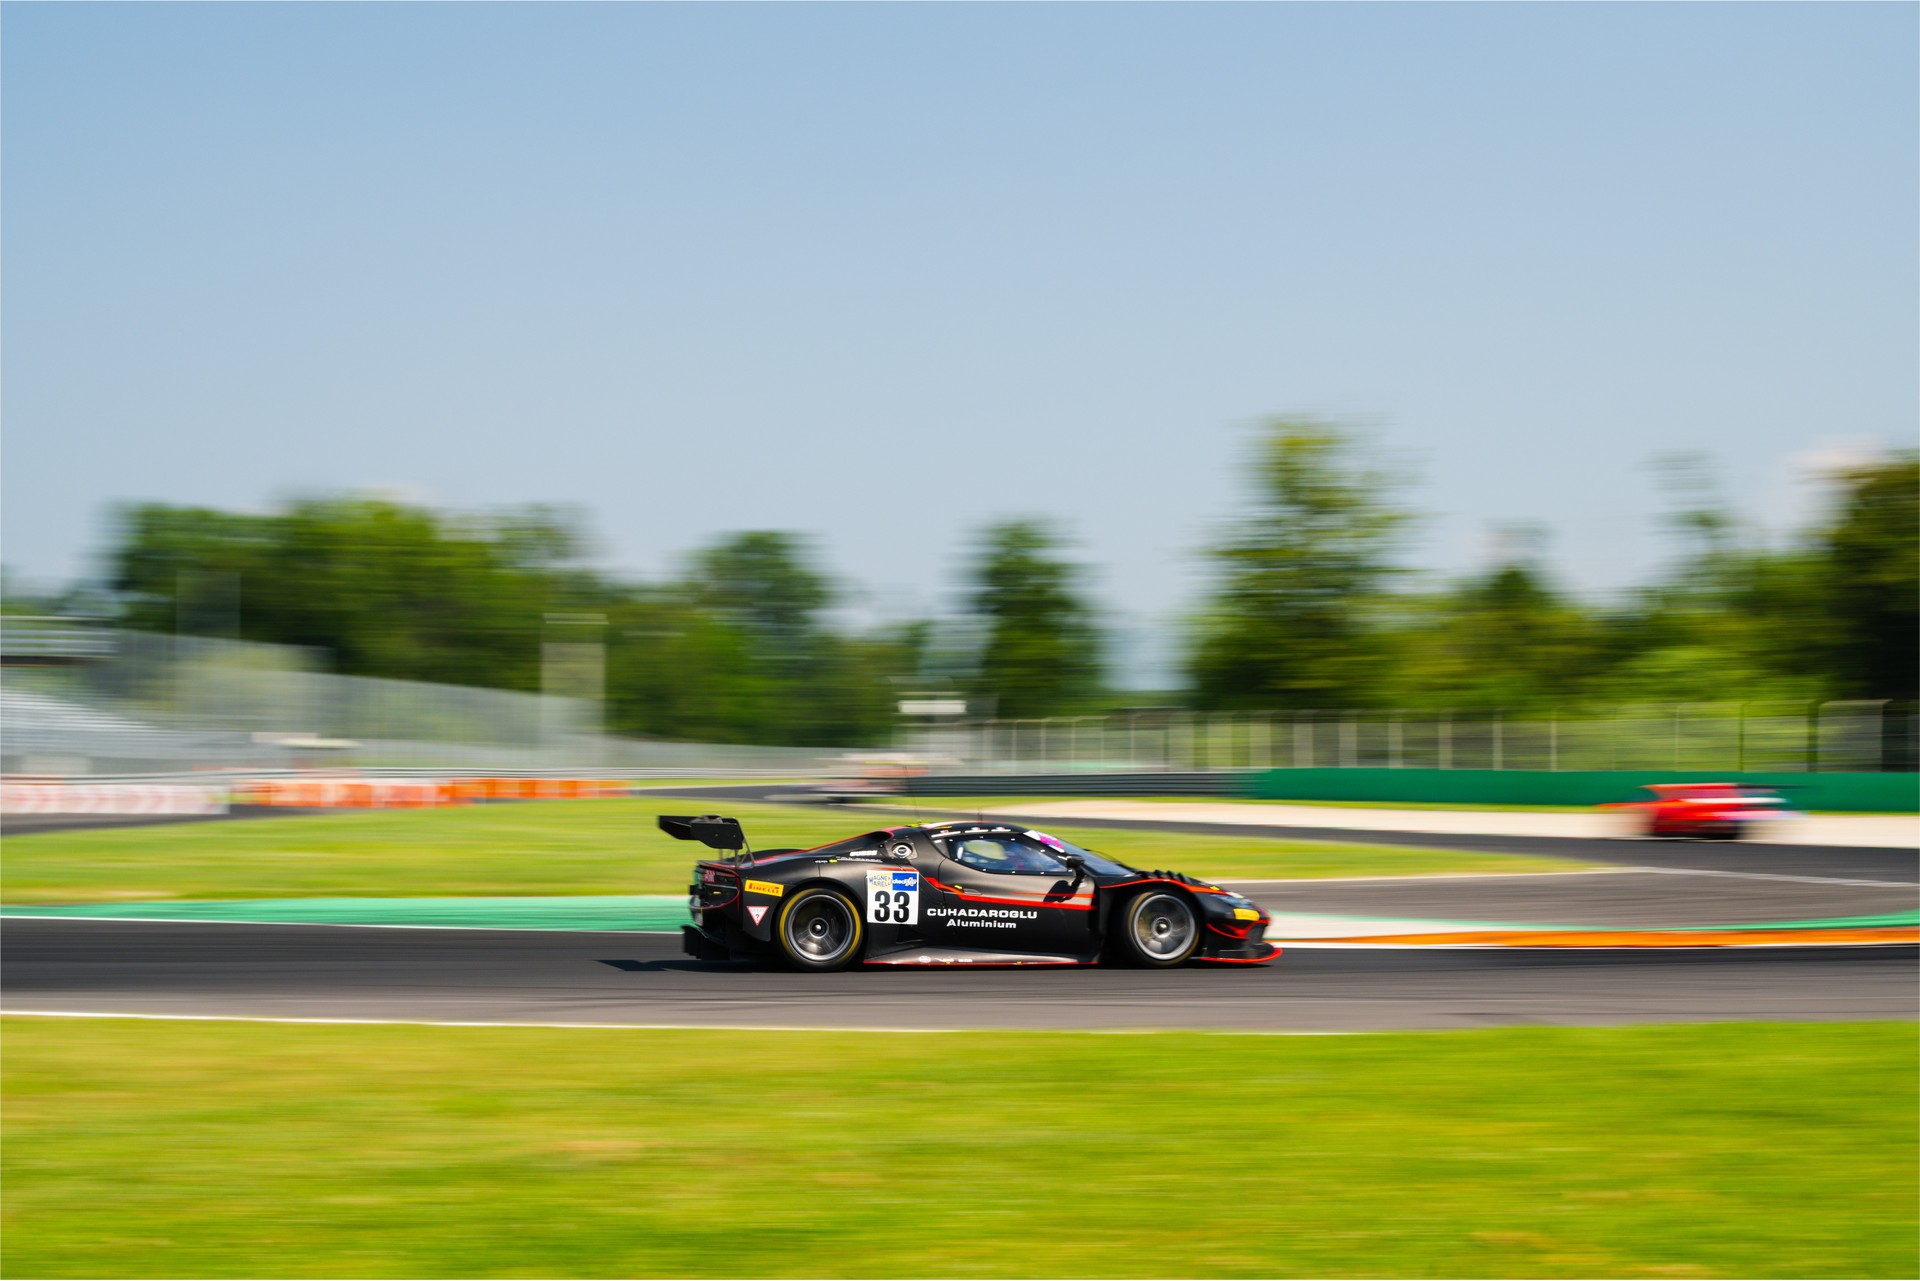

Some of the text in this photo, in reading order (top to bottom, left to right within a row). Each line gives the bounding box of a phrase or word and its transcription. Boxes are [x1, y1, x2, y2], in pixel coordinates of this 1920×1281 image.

[874, 890, 910, 923] 33
[926, 908, 1038, 919] CUHADAROGLU
[946, 919, 1017, 929] Aluminium
